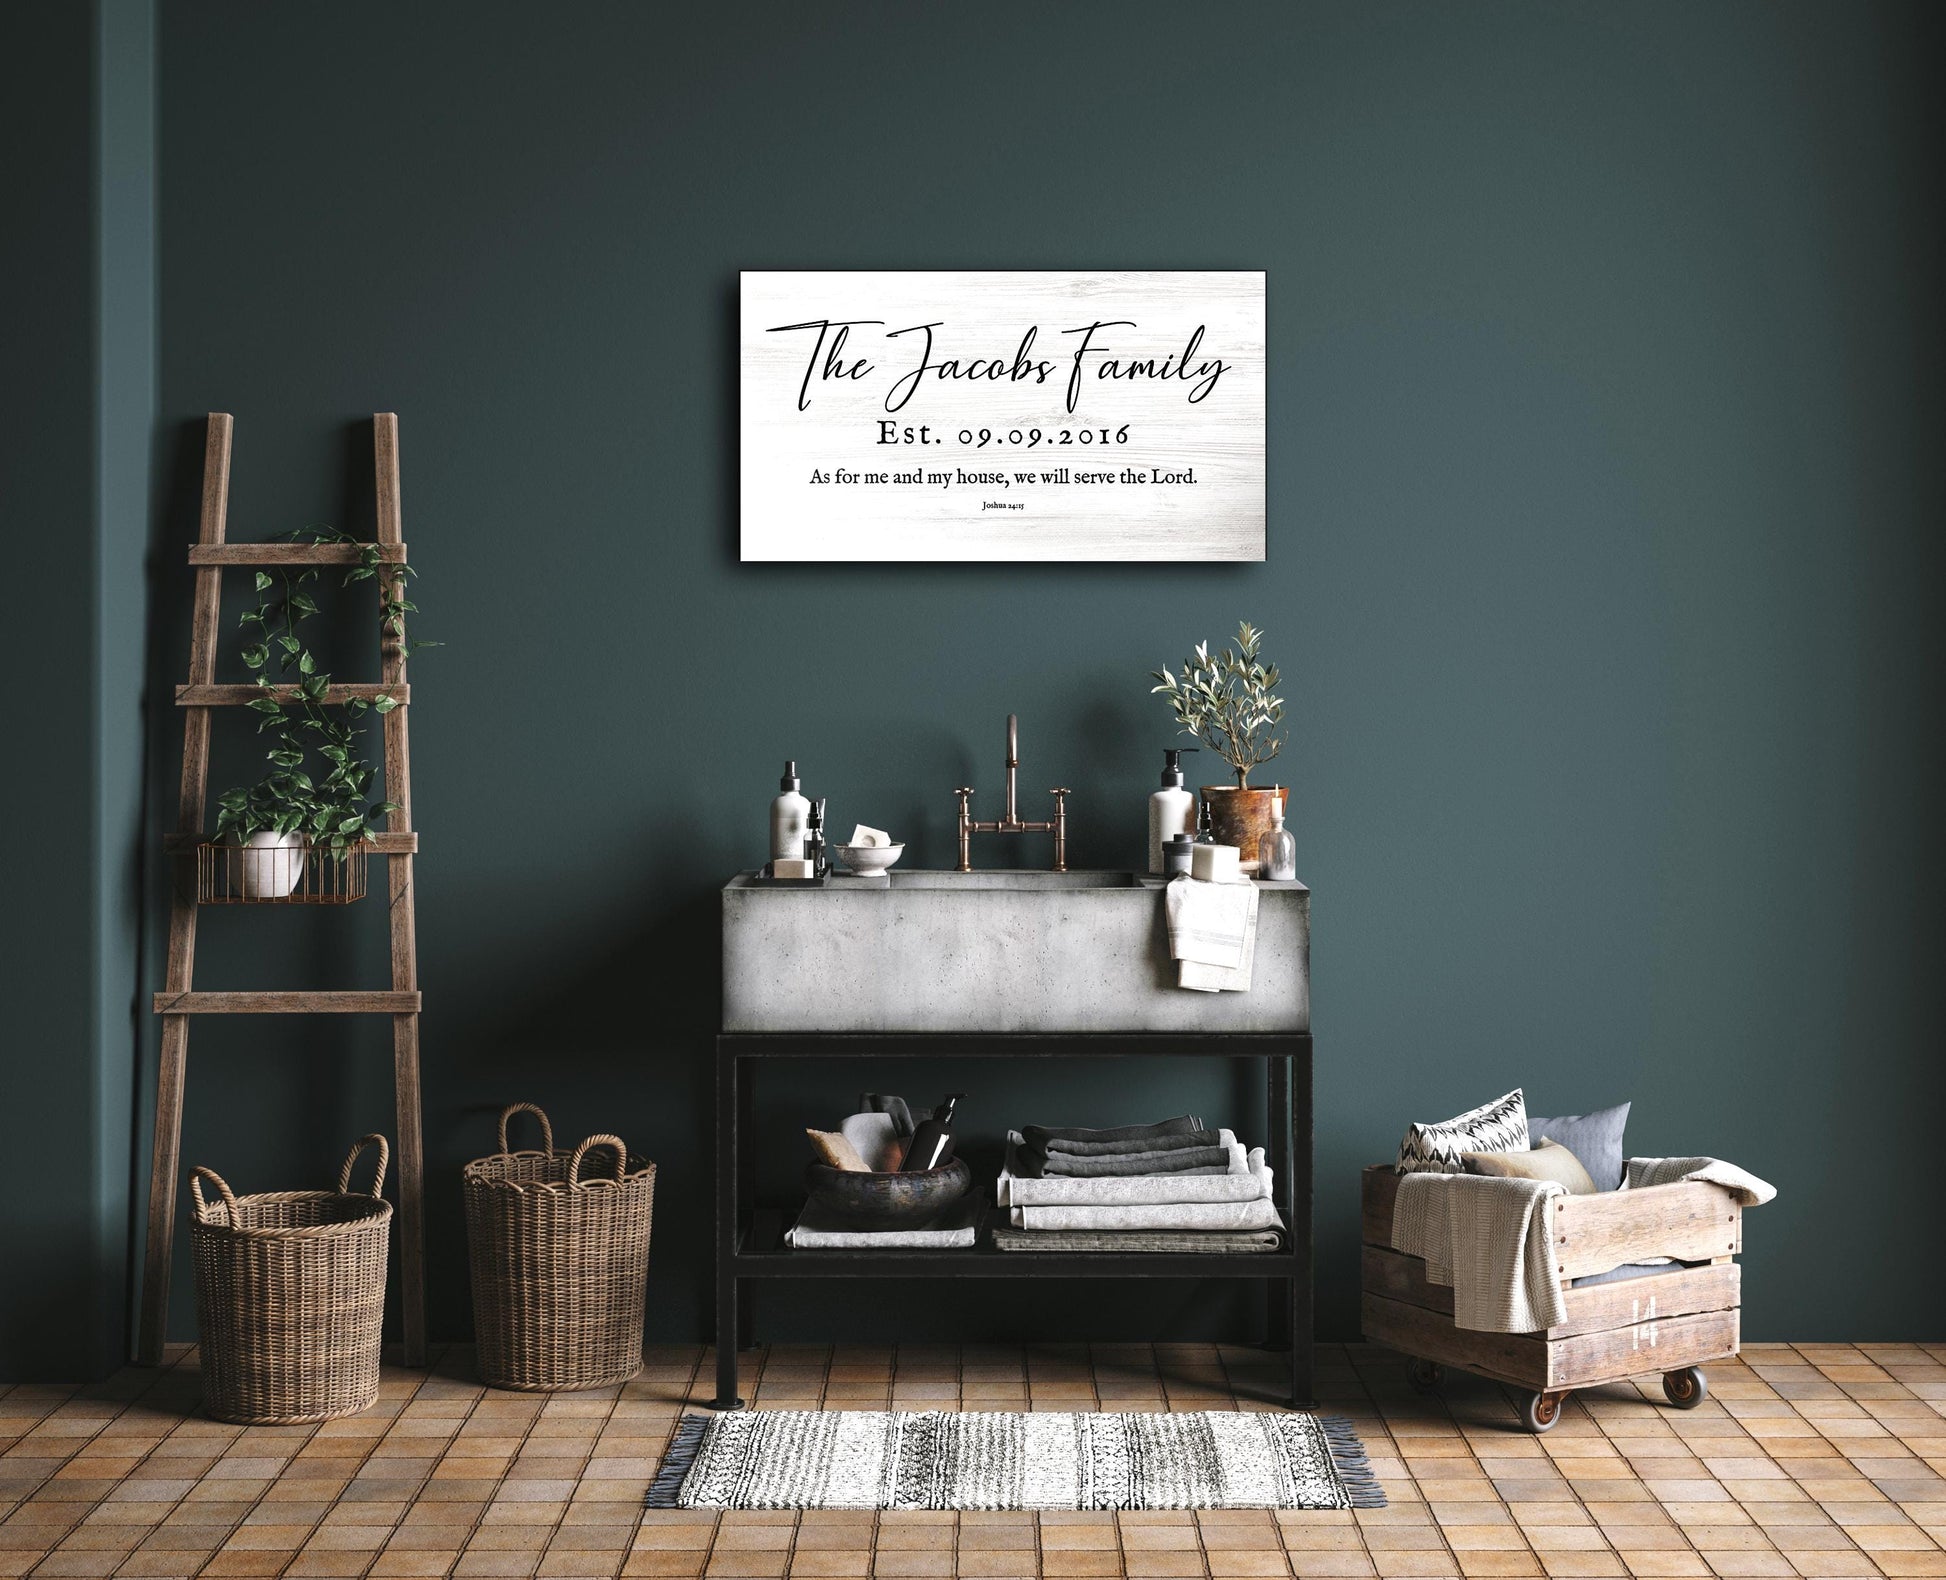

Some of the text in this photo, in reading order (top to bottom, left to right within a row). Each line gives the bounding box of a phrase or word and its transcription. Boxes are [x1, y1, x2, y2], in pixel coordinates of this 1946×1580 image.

[766, 319, 1232, 414] The Jacobs Family
[876, 420, 1130, 449] Est. 09.09.2016
[809, 467, 1198, 490] As for me and my house, we will serve the Lord.
[981, 501, 1007, 511] Joshua
[1632, 1295, 1658, 1350] 14
